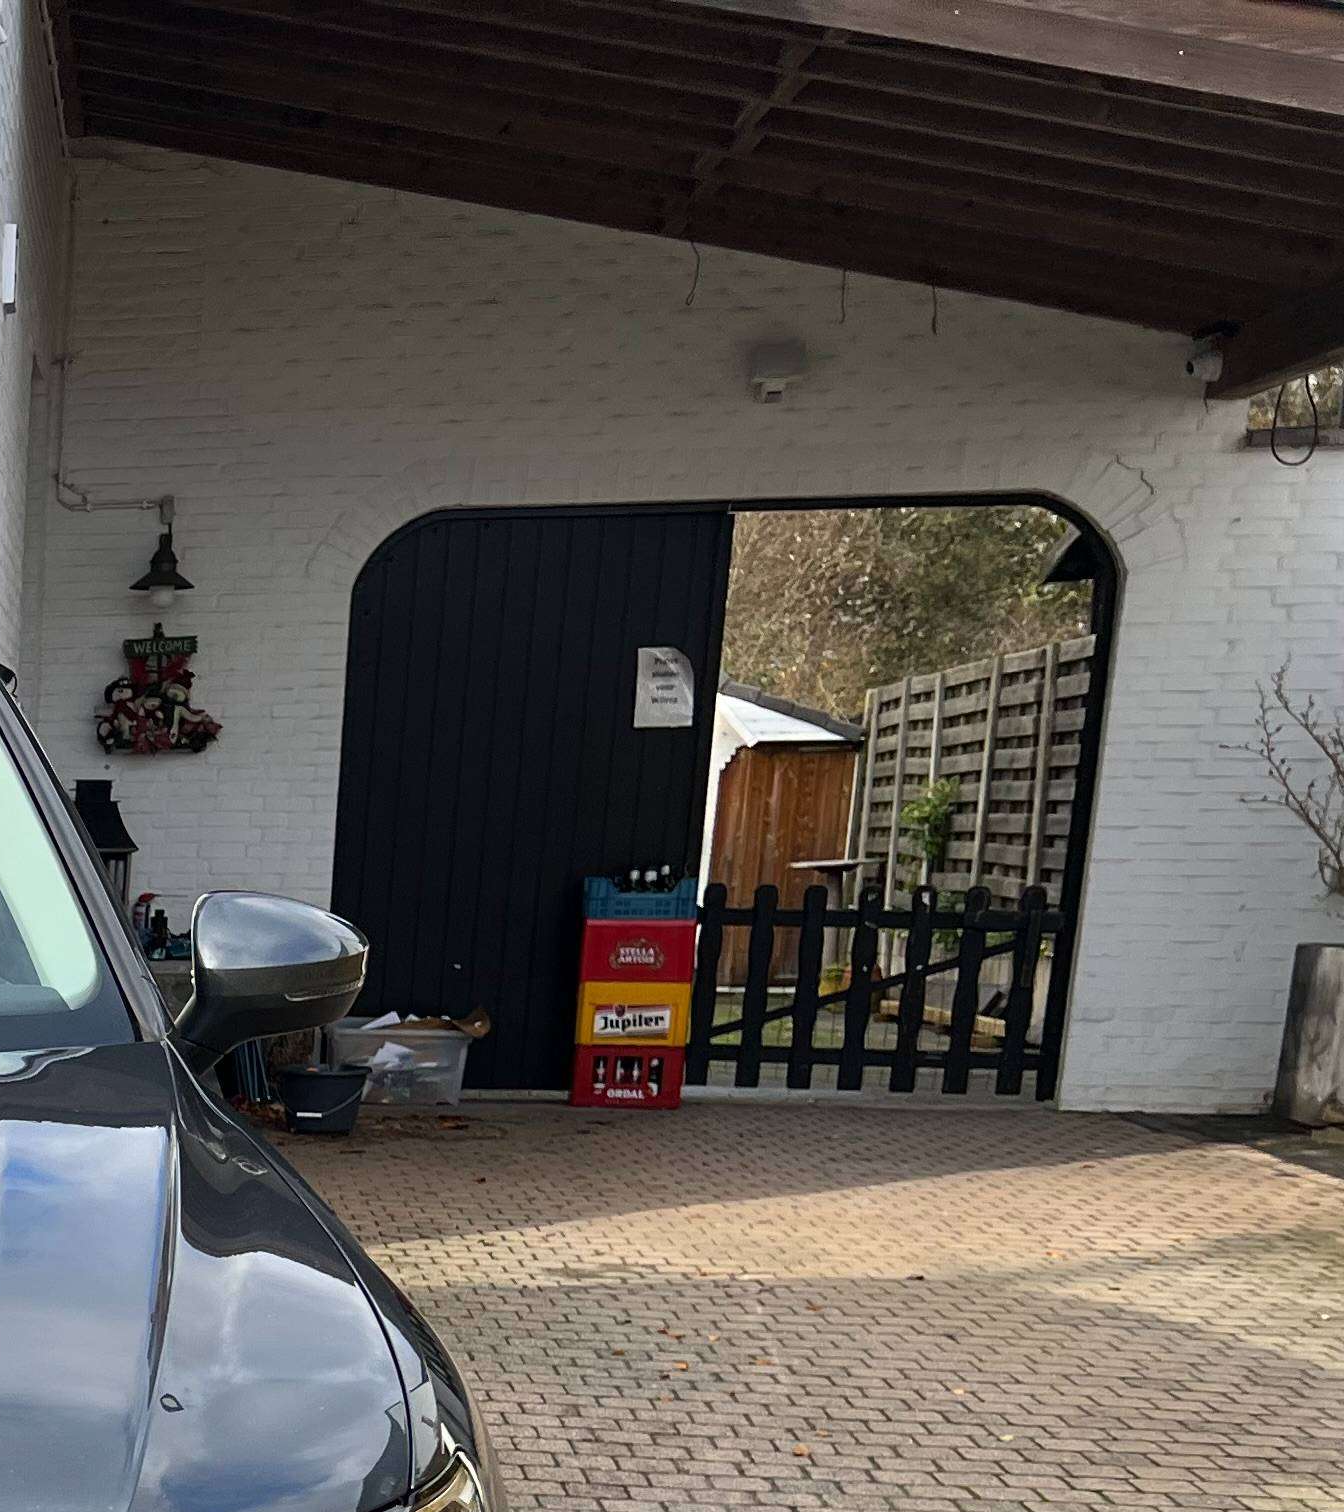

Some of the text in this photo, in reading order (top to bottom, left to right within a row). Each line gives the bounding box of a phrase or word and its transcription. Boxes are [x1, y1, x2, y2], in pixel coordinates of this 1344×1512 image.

[133, 639, 192, 654] WELCOME
[619, 947, 654, 956] STELLA
[606, 1088, 645, 1099] ORDAL
